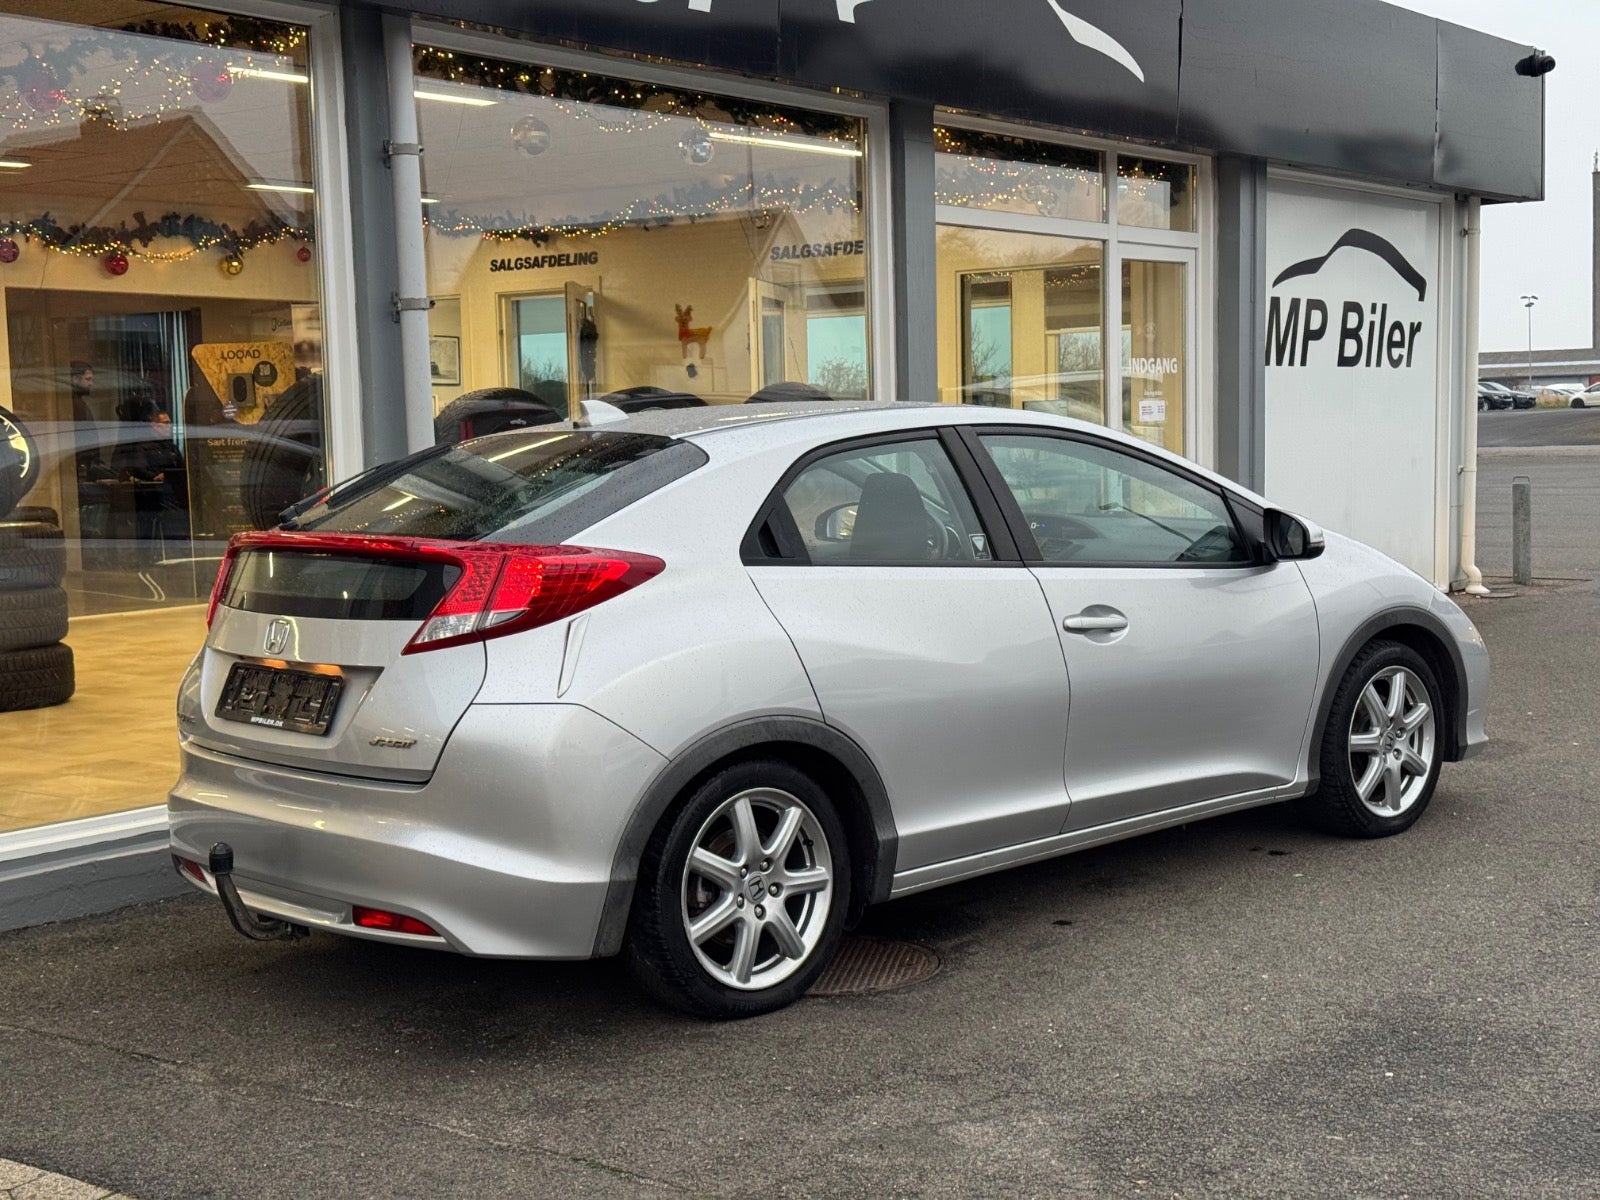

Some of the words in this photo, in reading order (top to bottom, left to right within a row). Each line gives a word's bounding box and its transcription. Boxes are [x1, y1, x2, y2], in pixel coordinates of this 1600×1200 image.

[769, 240, 864, 261] SALGSAFDE
[490, 251, 599, 272] SALGSAFDELING
[1265, 296, 1328, 367] MP
[1337, 301, 1422, 369] Biler
[221, 349, 261, 360] LOOAD
